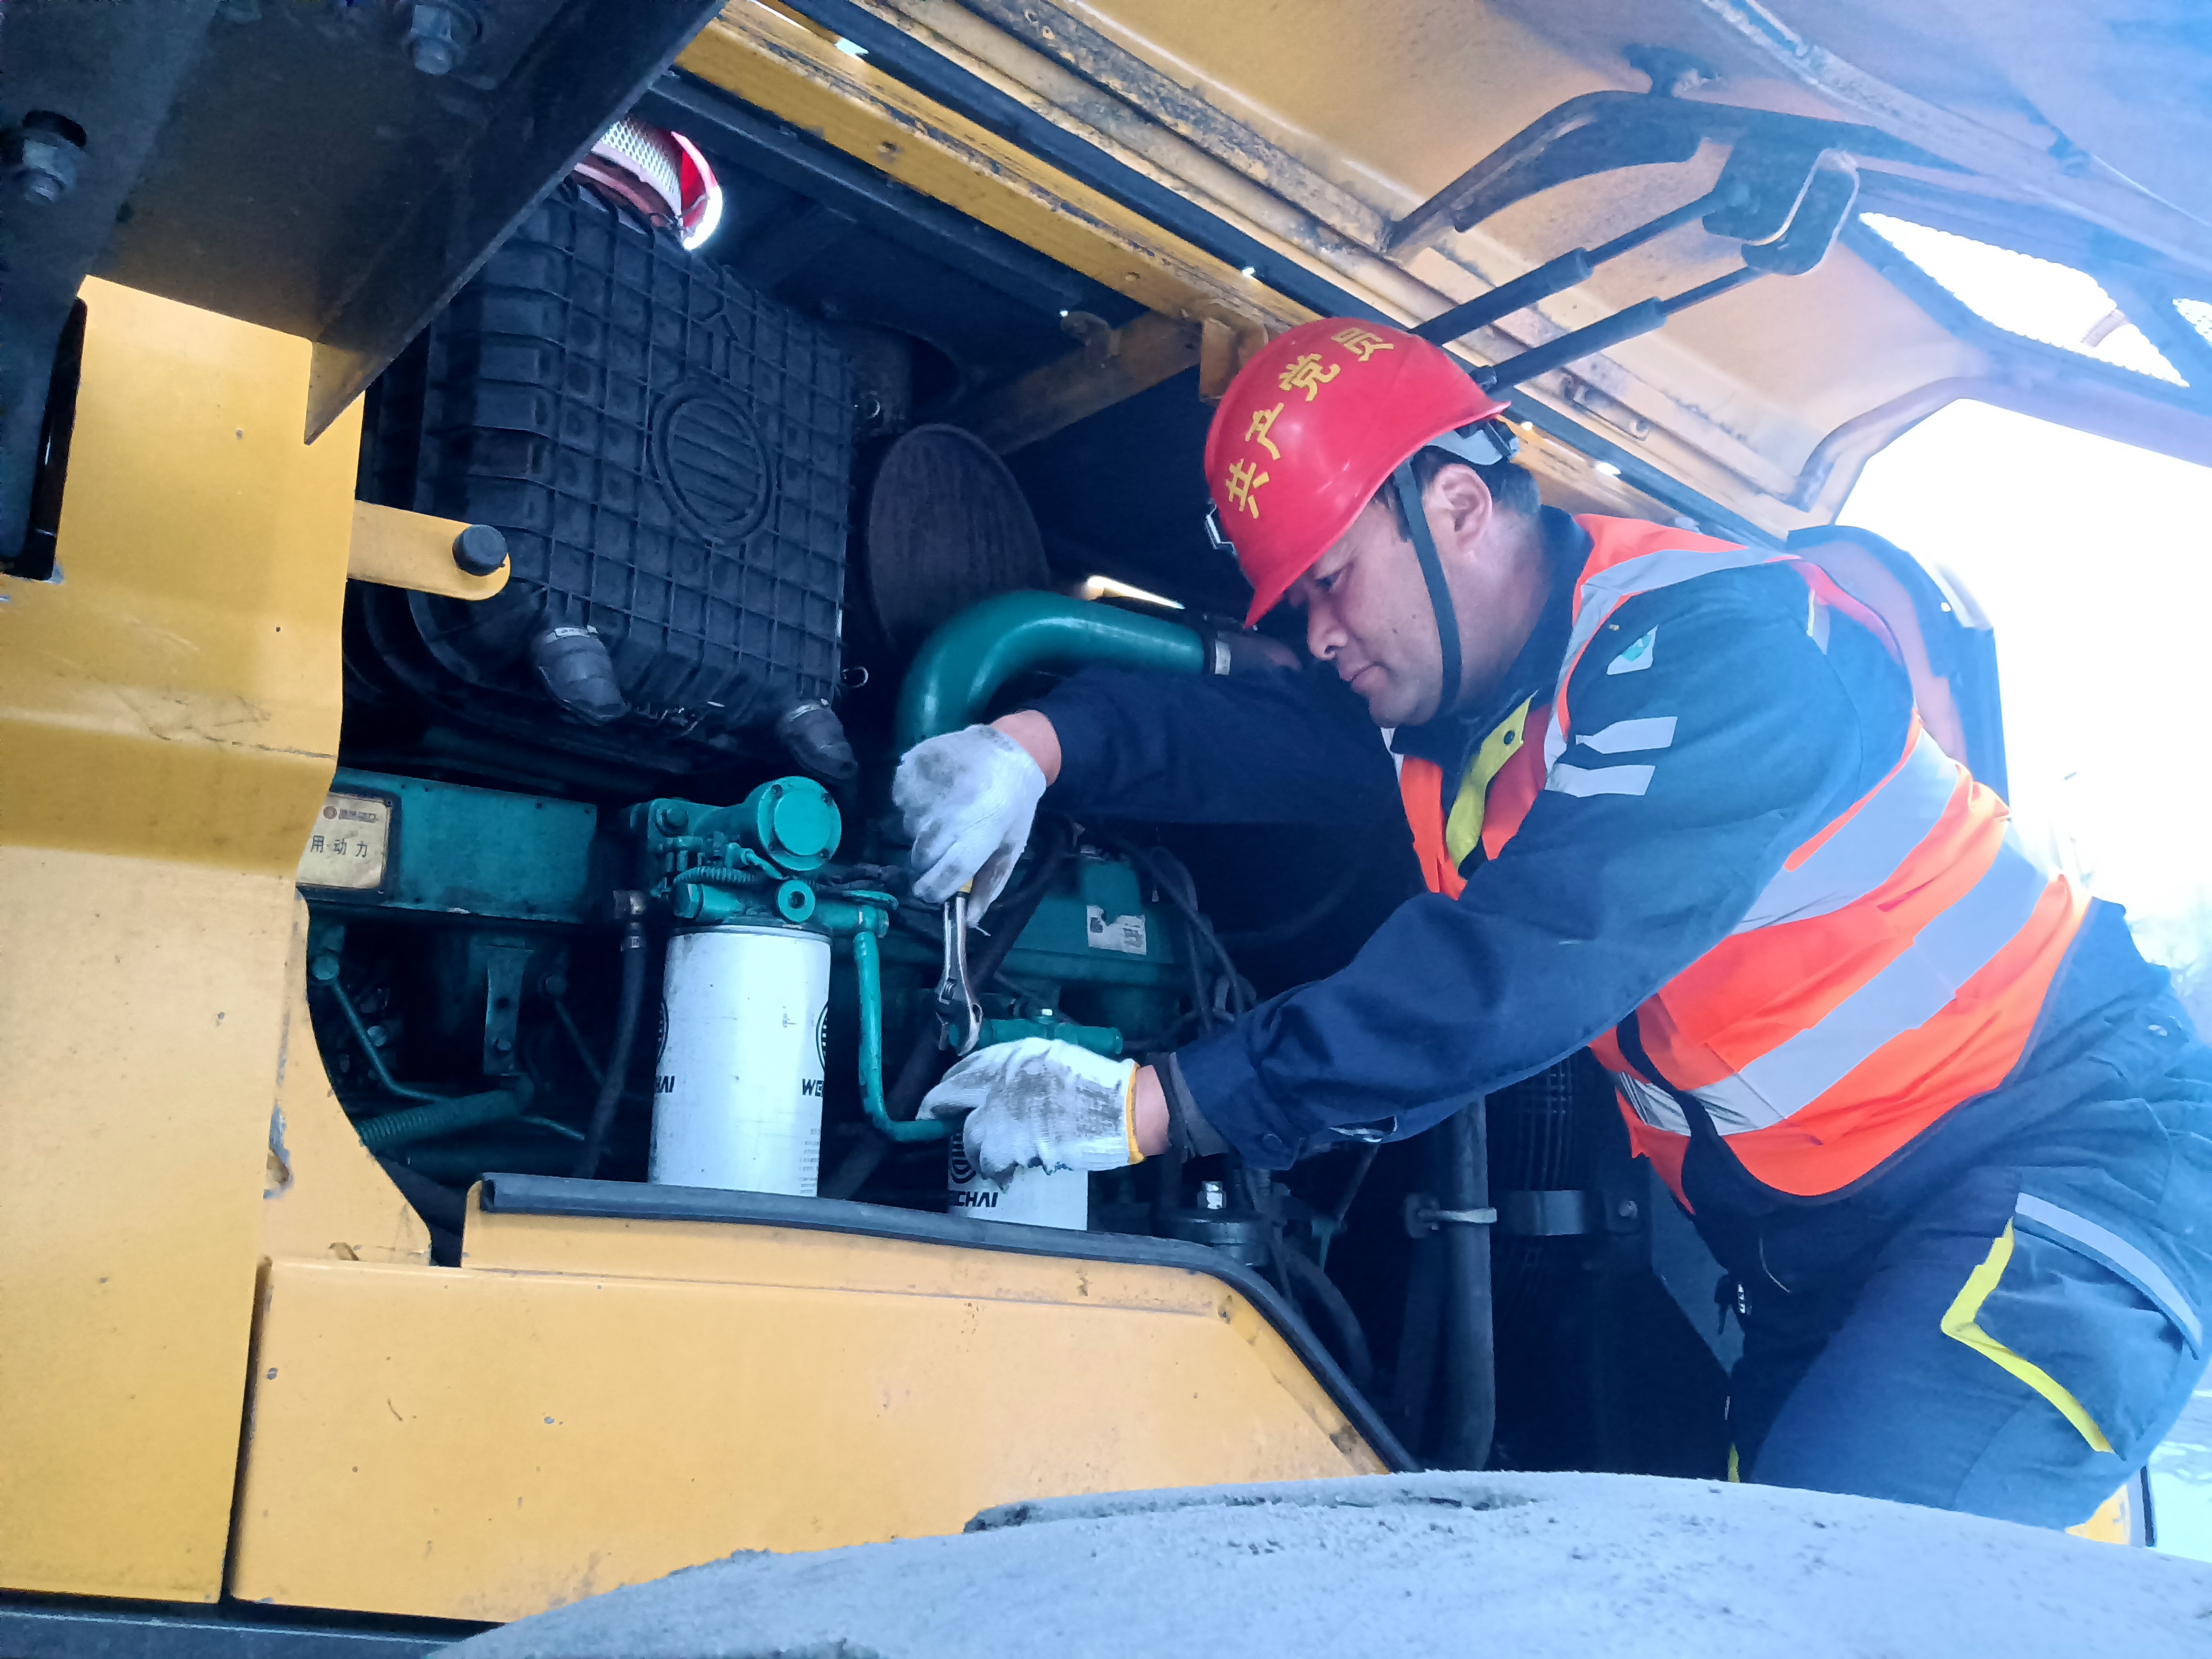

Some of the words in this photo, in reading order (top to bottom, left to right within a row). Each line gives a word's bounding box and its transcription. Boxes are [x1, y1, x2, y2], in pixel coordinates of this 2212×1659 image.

[1225, 327, 1394, 519] 共产党员
[310, 835, 368, 858] 用动力
[802, 1078, 823, 1097] WE
